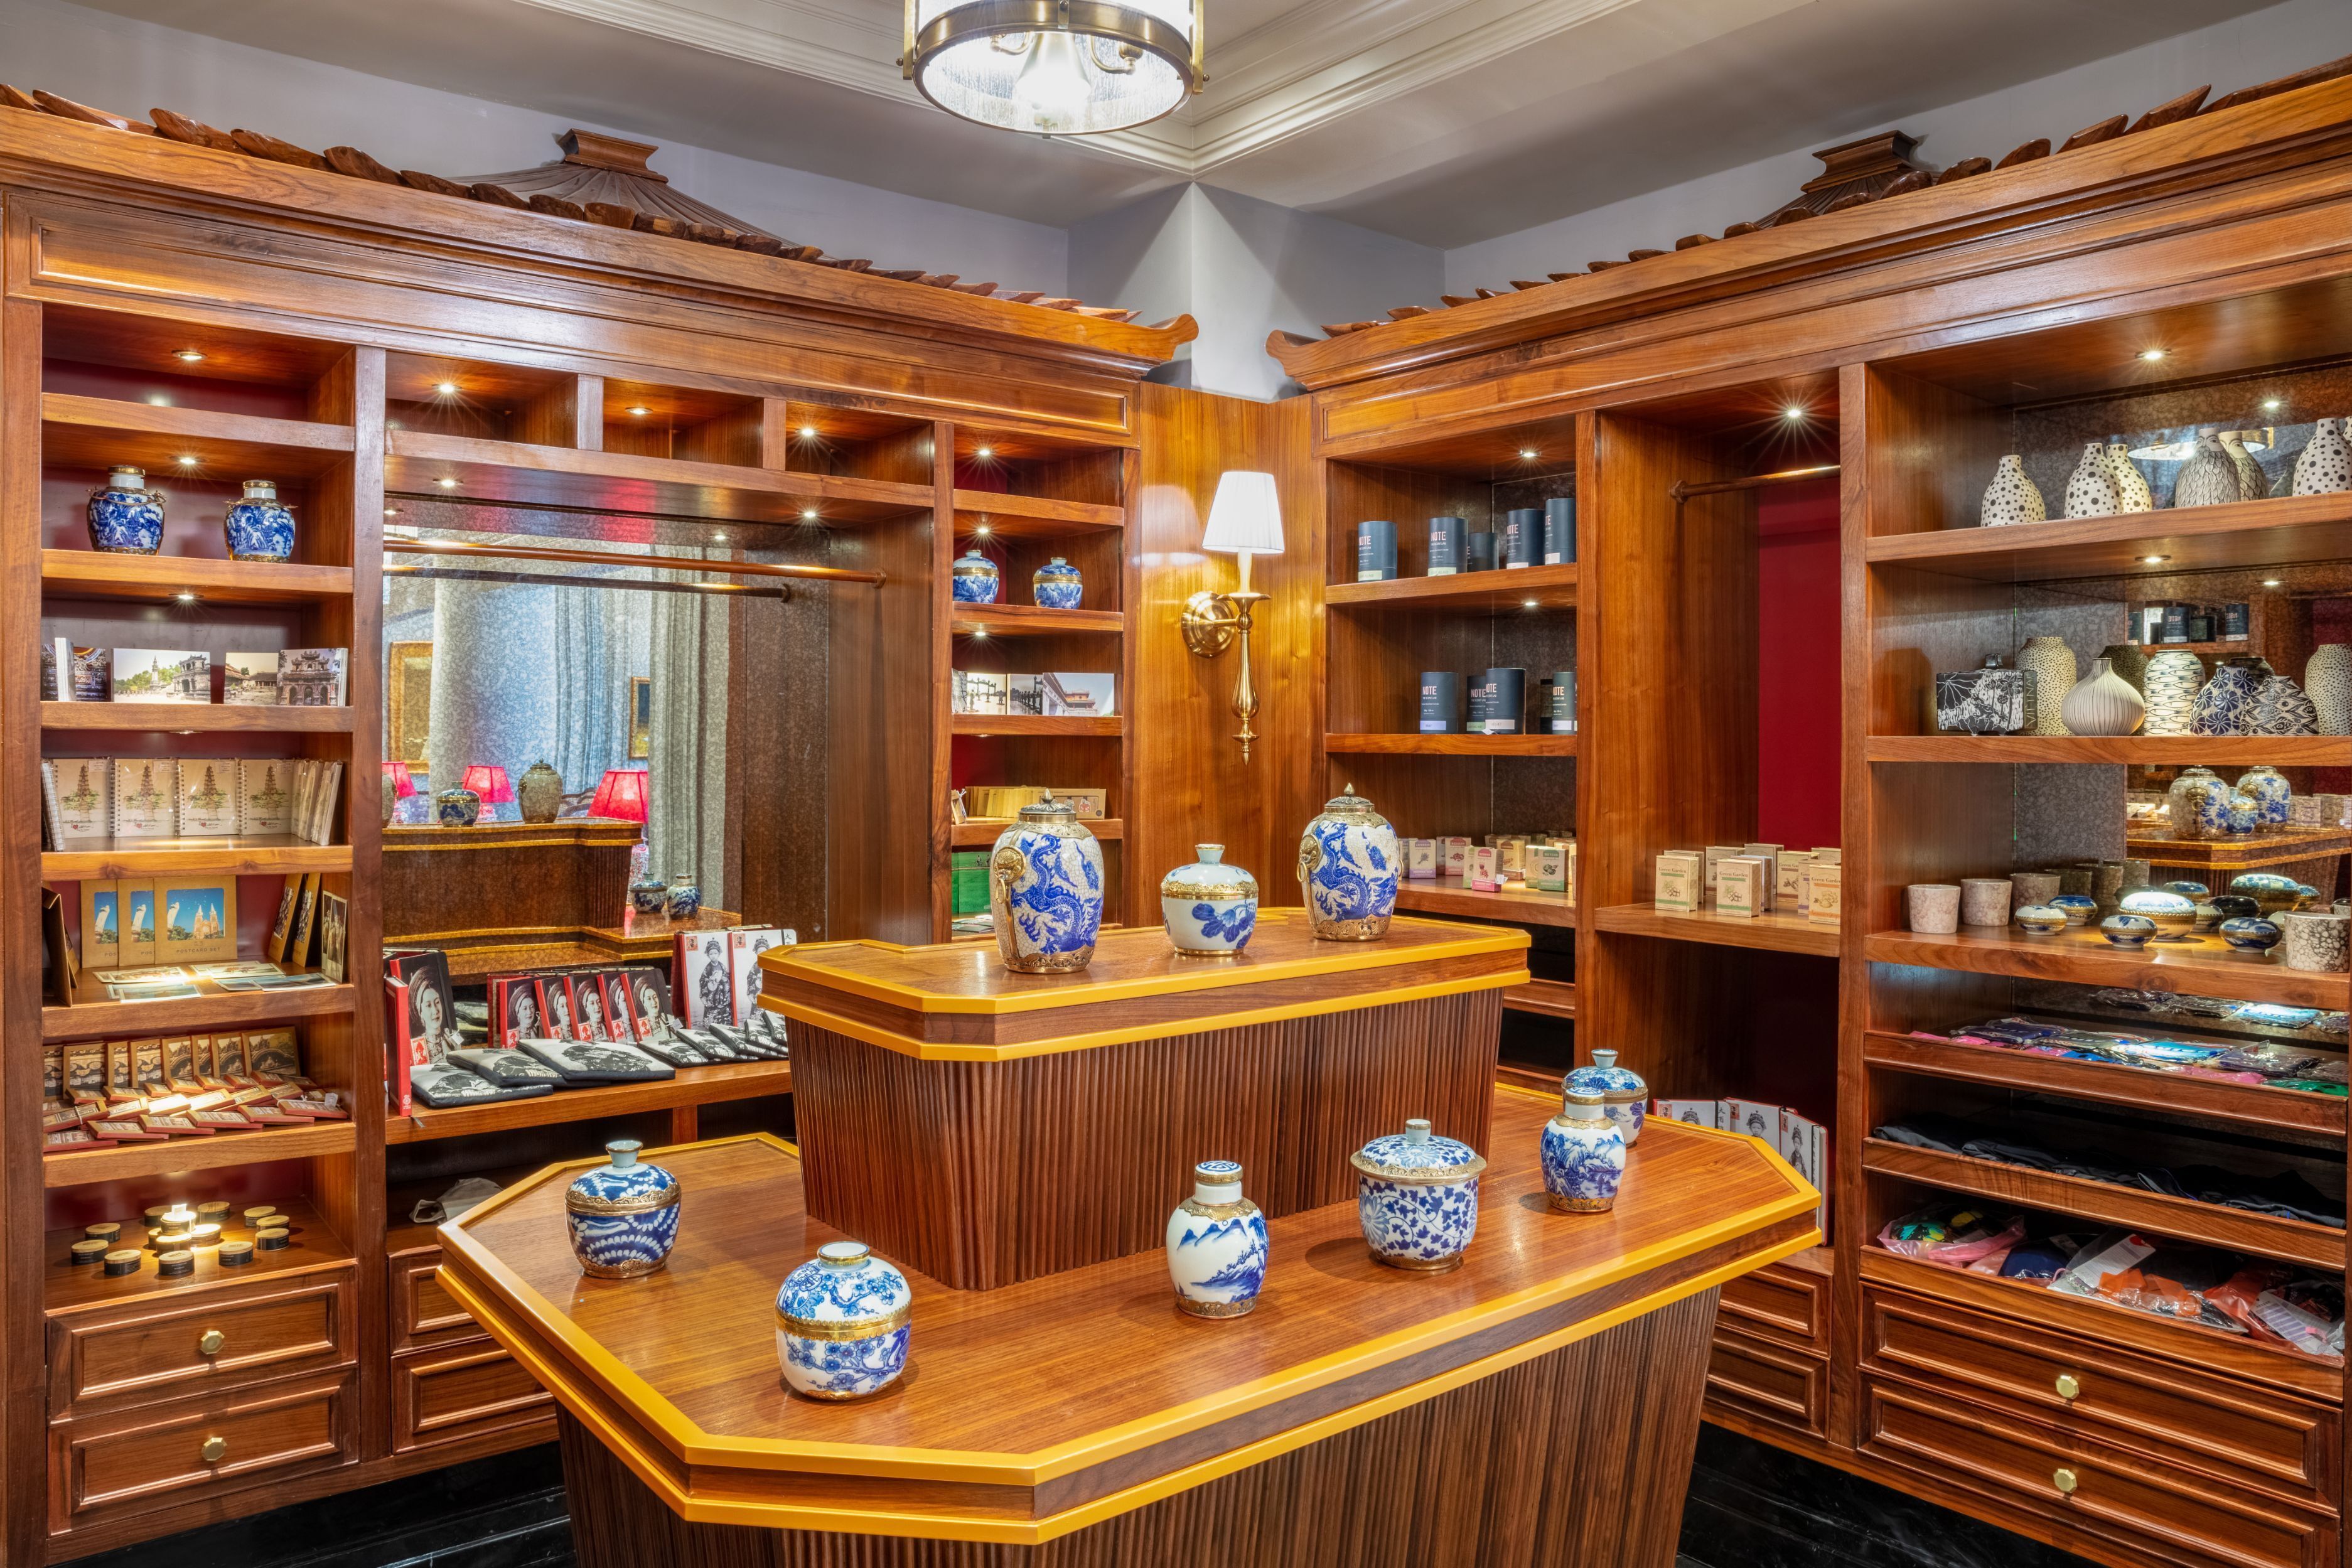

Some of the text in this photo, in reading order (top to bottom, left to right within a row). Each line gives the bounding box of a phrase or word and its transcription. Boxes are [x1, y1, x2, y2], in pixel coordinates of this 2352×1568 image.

[1358, 535, 1372, 546] NOTE
[1431, 531, 1446, 541] NOTE
[1422, 686, 1437, 695] NOTE
[1471, 689, 1486, 697] NOTE
